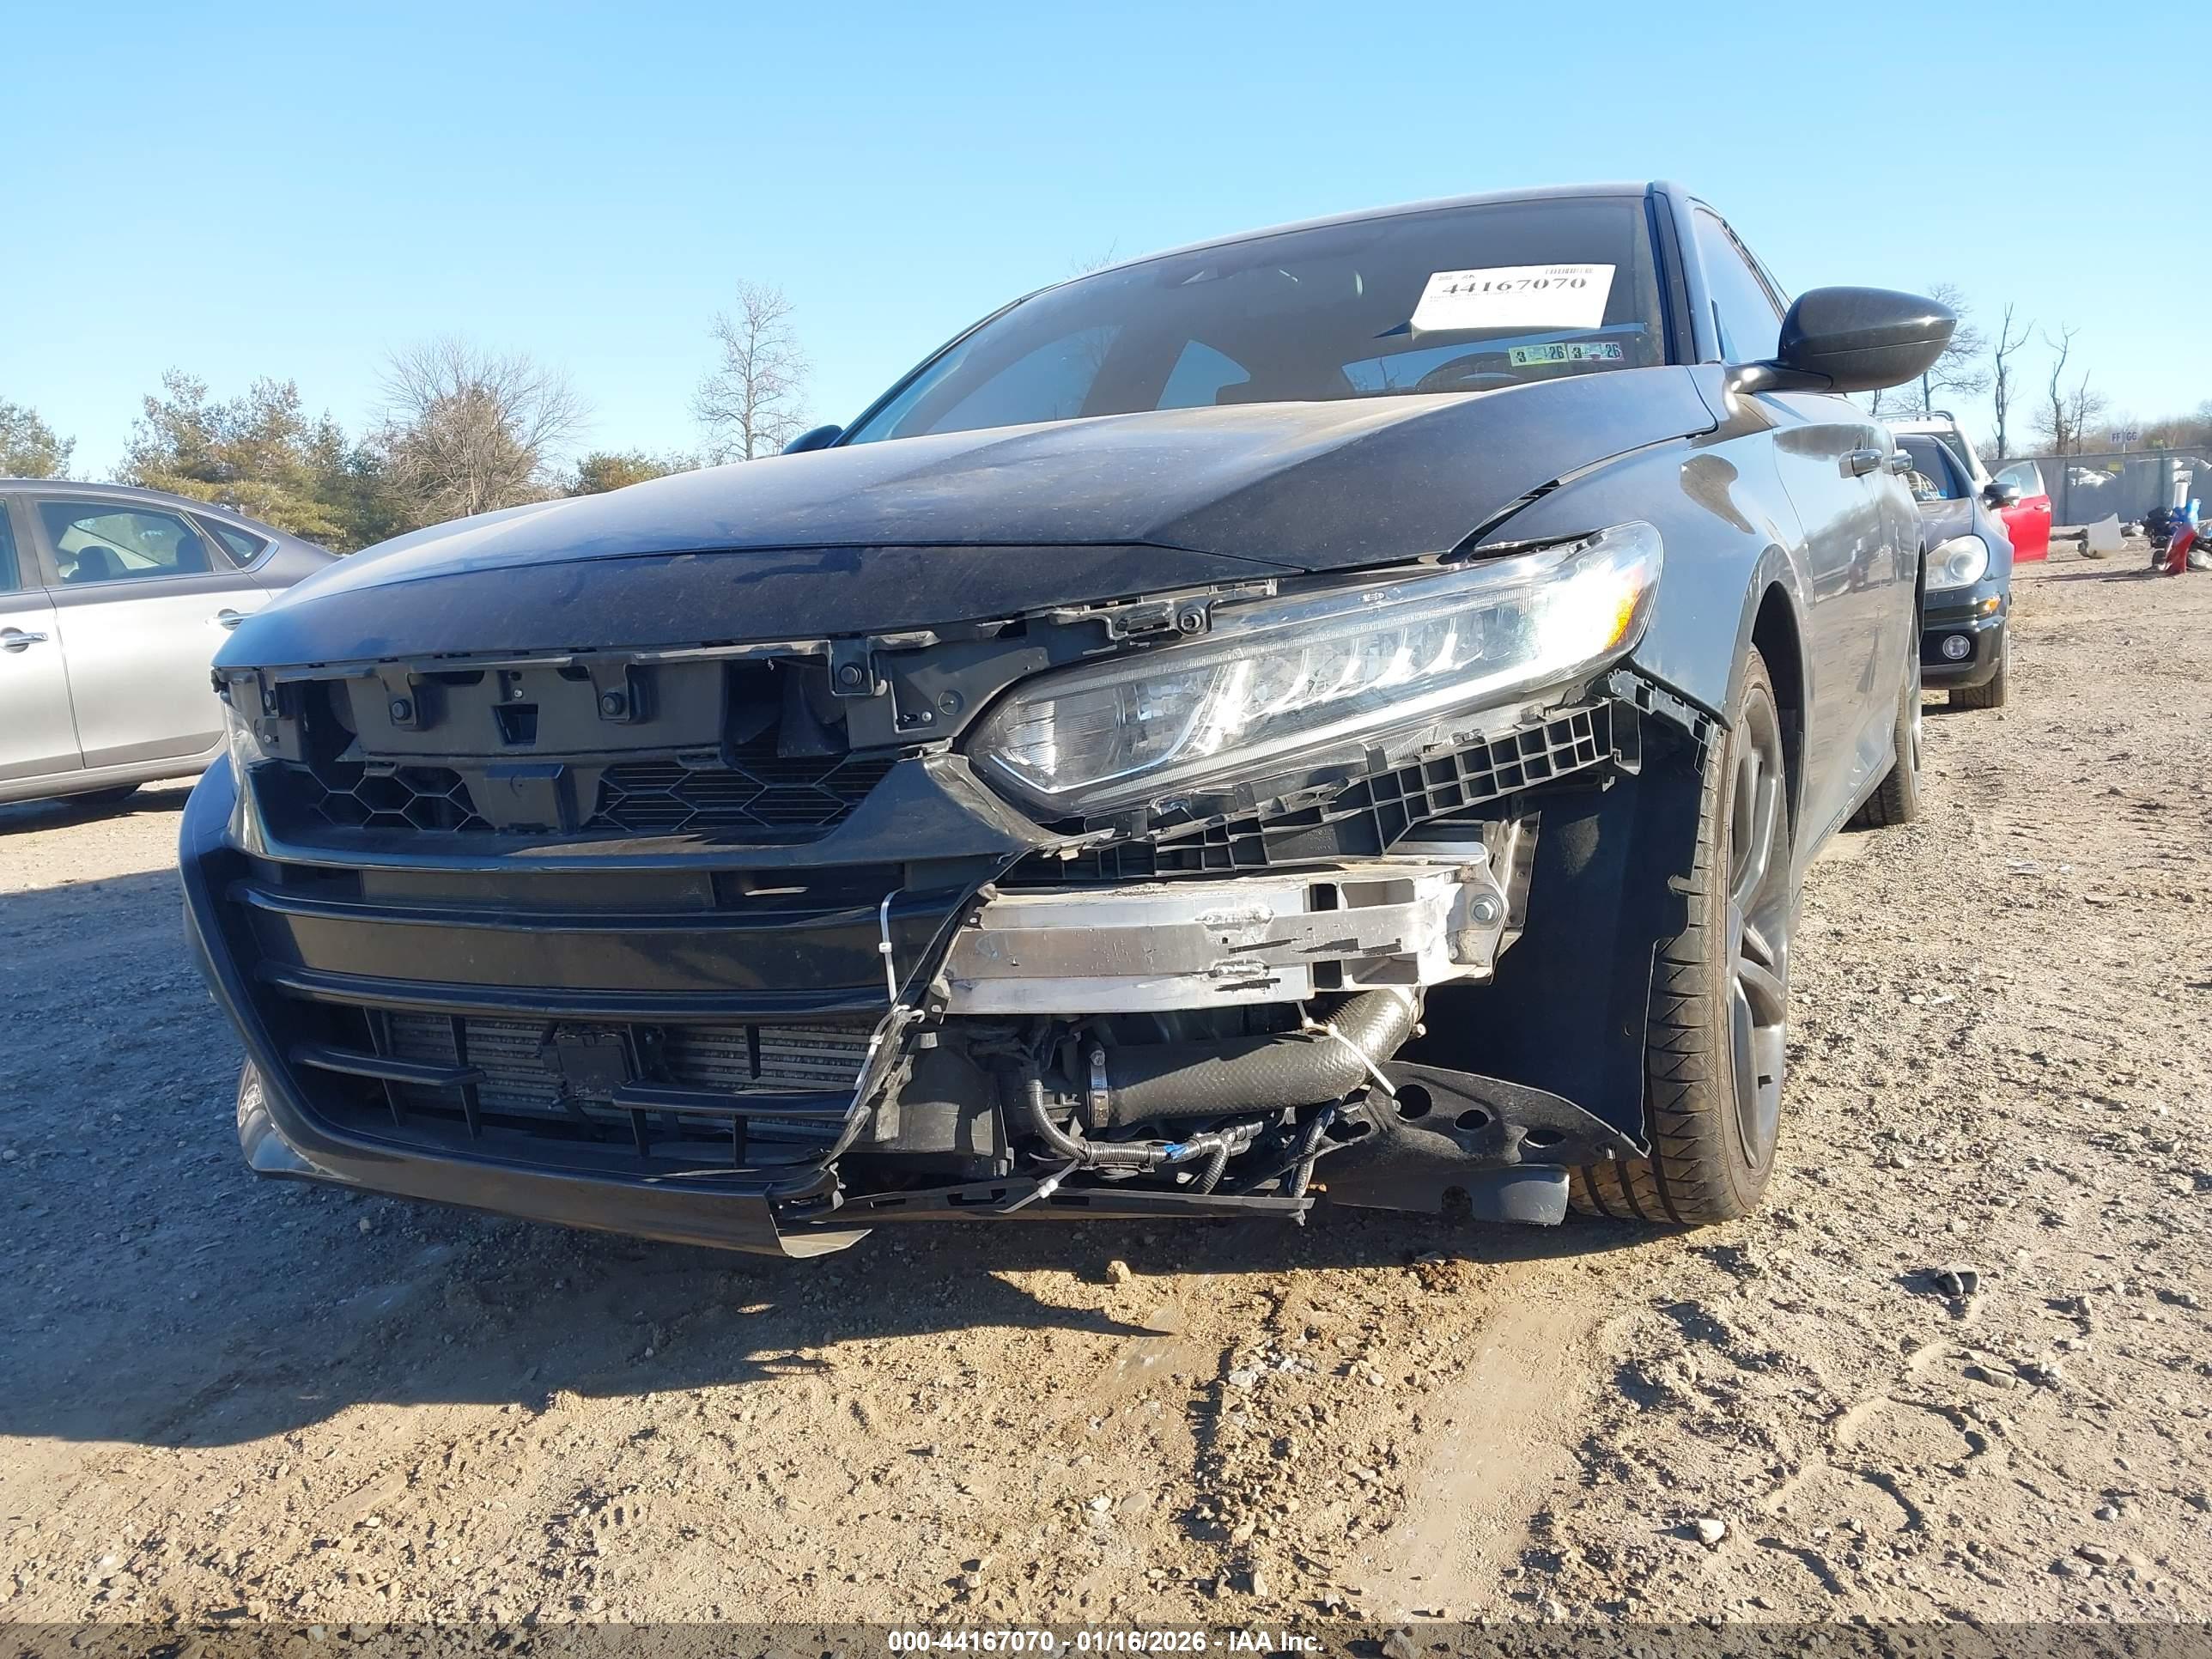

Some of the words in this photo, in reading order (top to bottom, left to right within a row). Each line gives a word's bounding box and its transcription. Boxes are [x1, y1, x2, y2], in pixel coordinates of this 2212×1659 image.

[1443, 277, 1587, 295] 44167070
[1516, 351, 1527, 362] 3
[1549, 345, 1565, 360] 26
[1572, 347, 1582, 358] 3
[1606, 343, 1620, 358] 26
